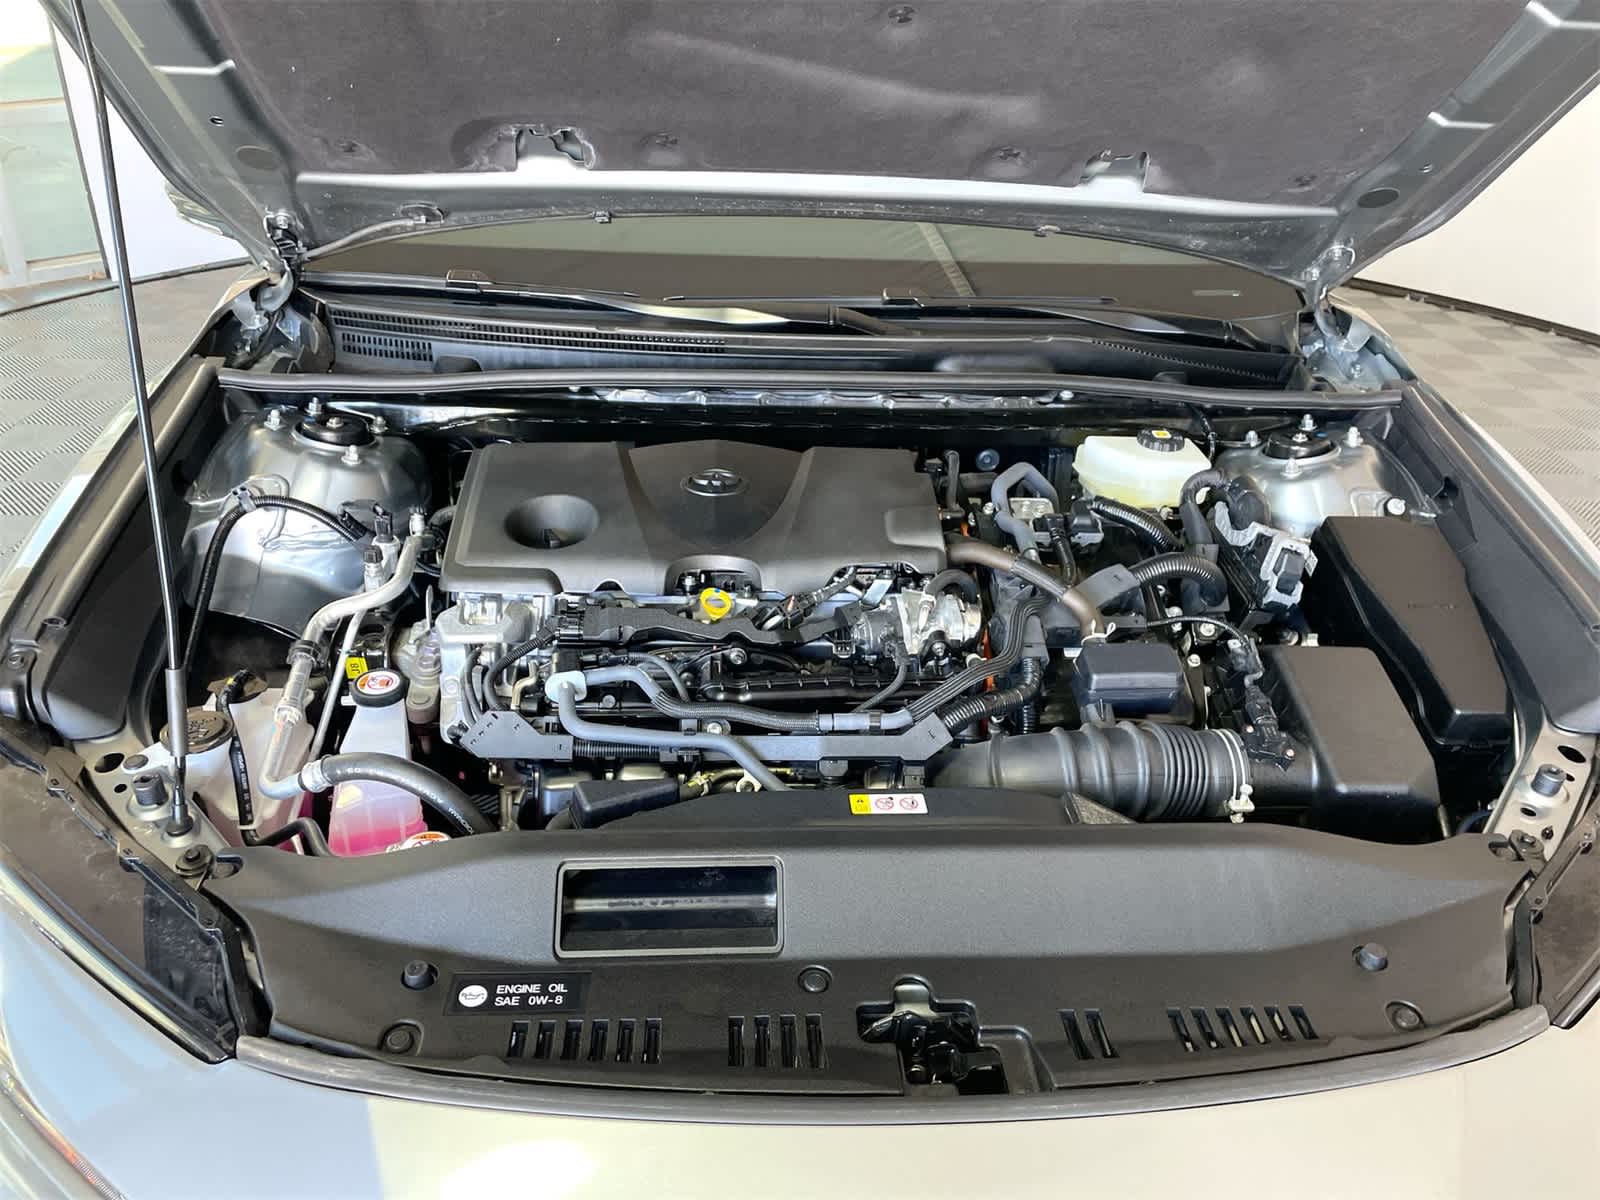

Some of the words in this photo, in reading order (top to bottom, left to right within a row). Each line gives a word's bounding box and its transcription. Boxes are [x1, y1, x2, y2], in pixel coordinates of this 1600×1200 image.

[496, 984, 541, 994] ENGINE
[548, 983, 568, 993] OIL
[494, 996, 520, 1006] SAE
[528, 995, 563, 1006] 0W-8
